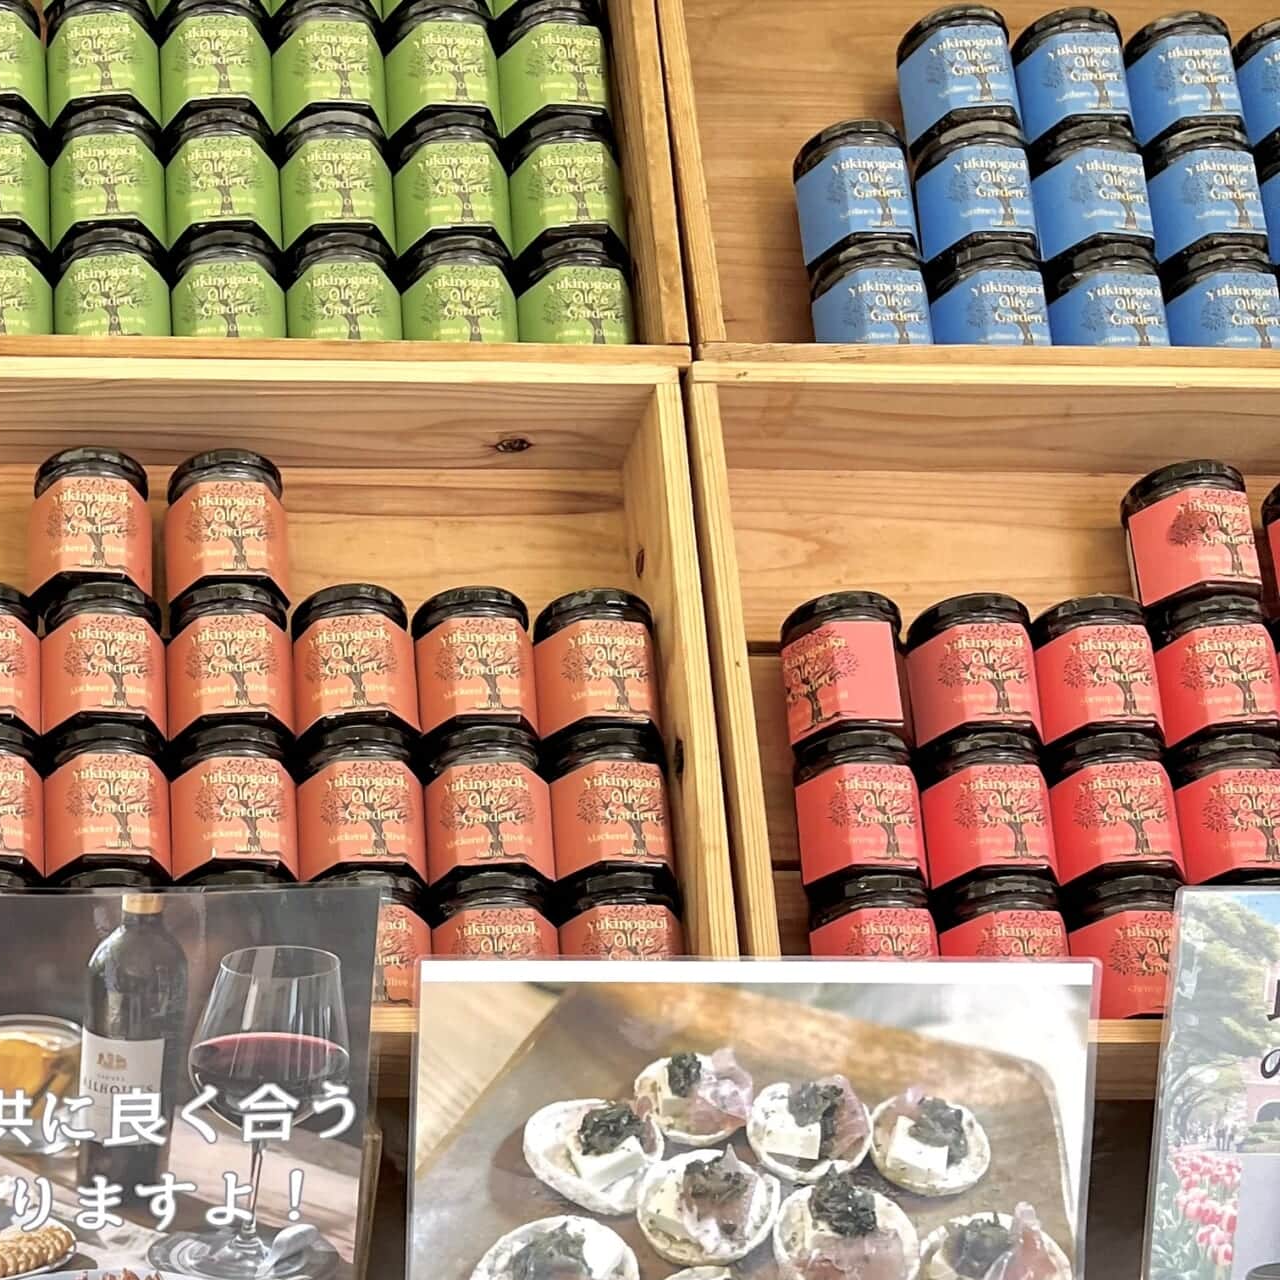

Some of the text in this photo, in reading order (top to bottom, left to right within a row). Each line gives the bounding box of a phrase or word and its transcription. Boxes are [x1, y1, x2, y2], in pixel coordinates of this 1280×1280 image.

[955, 49, 992, 64] Olive
[1073, 55, 1111, 70] Olive
[951, 62, 1000, 76] Garden
[1069, 69, 1118, 83] Garden
[74, 504, 112, 519] Olive
[214, 508, 252, 523] Olive
[67, 520, 122, 536] Garden
[207, 523, 261, 539] Garden
[94, 642, 132, 658] Olive
[214, 643, 254, 658] Olive
[331, 644, 370, 659] Olive
[465, 645, 504, 661] Olive
[594, 646, 634, 662] Olive
[87, 659, 142, 676] Garden
[207, 659, 262, 676] Garden
[324, 660, 380, 677] Garden
[459, 661, 514, 678] Garden
[588, 662, 641, 680] Garden
[97, 782, 136, 798] Olive
[226, 785, 266, 802] Olive
[351, 789, 391, 805] Olive
[610, 790, 649, 806] Olive
[468, 790, 508, 807] Olive
[90, 799, 145, 816] Garden
[219, 803, 275, 819] Garden
[345, 807, 400, 823] Garden
[604, 807, 658, 824] Garden
[462, 808, 517, 825] Garden
[480, 938, 520, 954] Olive
[614, 934, 654, 949] Olive
